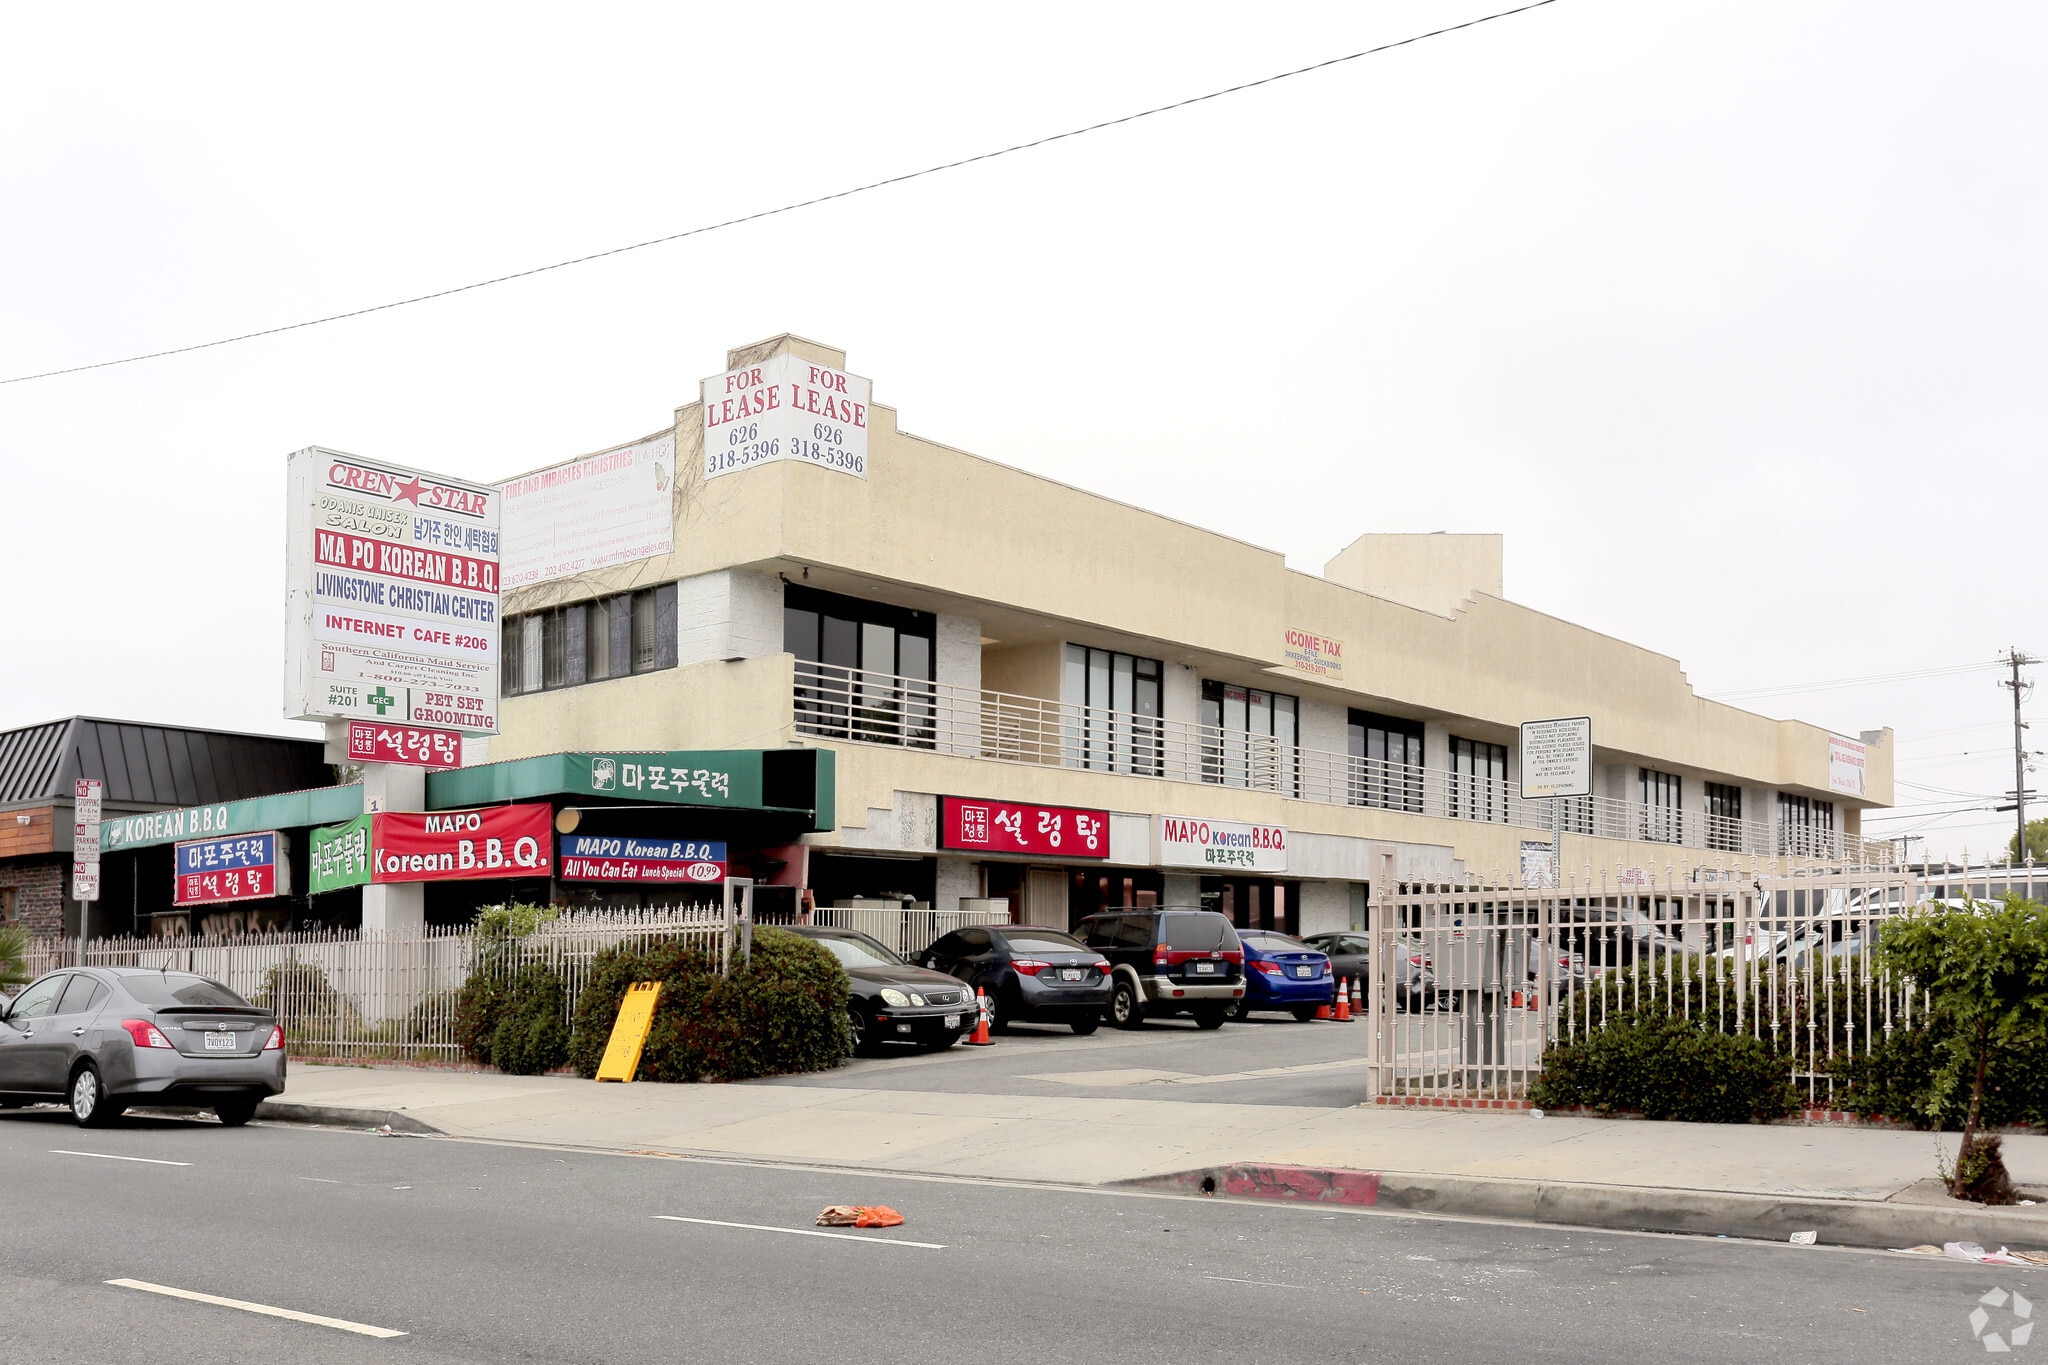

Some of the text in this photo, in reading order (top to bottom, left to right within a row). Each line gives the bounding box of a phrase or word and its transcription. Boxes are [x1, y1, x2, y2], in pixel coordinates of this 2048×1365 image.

[726, 368, 763, 394] FOR
[809, 366, 848, 394] FOR
[708, 385, 780, 428] LEASE
[792, 384, 866, 428] LEASE
[730, 422, 758, 446] 626
[814, 422, 842, 446] 626
[708, 438, 779, 473] 318-5396
[791, 438, 862, 473] 318-5396
[506, 482, 522, 500] FIRE
[523, 477, 540, 495] AND
[541, 464, 582, 490] MIRACLES
[584, 450, 632, 478] MINISTRIES
[329, 464, 395, 494] CREN
[430, 486, 486, 515] STAR
[326, 514, 402, 538] SALON
[366, 506, 408, 526] UNISEX
[414, 517, 441, 544] 남가주
[444, 523, 462, 548] 한인
[464, 528, 498, 556] 세탁협회
[320, 532, 498, 592] MA PO KOREAN B.B.Q.
[316, 572, 494, 623] LIVINGSTONE CHRISTIAN CENTER
[326, 614, 488, 651] INTERNET CAFE #206
[322, 642, 490, 672] Southern California Maid Service
[1322, 640, 1340, 657] TAX
[358, 672, 480, 692] 1-800-273-7033
[388, 662, 418, 674] Carpet
[420, 666, 460, 678] Cleaning
[328, 694, 358, 707] #201
[330, 685, 358, 694] SUITE
[372, 696, 390, 704] GEC
[425, 692, 484, 712] PET SET
[414, 708, 494, 728] GROOMING
[78, 787, 87, 796] NO
[622, 764, 728, 798] 마포주물럭
[78, 798, 99, 807] STOPPING
[370, 800, 378, 812] 1
[125, 806, 228, 842] KOREAN B.B.Q
[425, 813, 482, 834] MAPO
[965, 810, 986, 822] 마포
[76, 825, 84, 835] NO
[1164, 819, 1210, 844] MAPO
[1252, 827, 1286, 851] B.B.Q.
[189, 840, 264, 868] 마포주물럭
[312, 827, 368, 882] 마포주물럭
[375, 836, 548, 874] Korean B.B.Q.
[576, 838, 712, 860] MAPO Korean B.B.Q.
[1206, 848, 1254, 866] 마포주물럭
[74, 863, 85, 872] NO
[564, 859, 716, 880] All You Can Eat Lunch Special 10.99
[203, 870, 262, 896] 설렁탕
